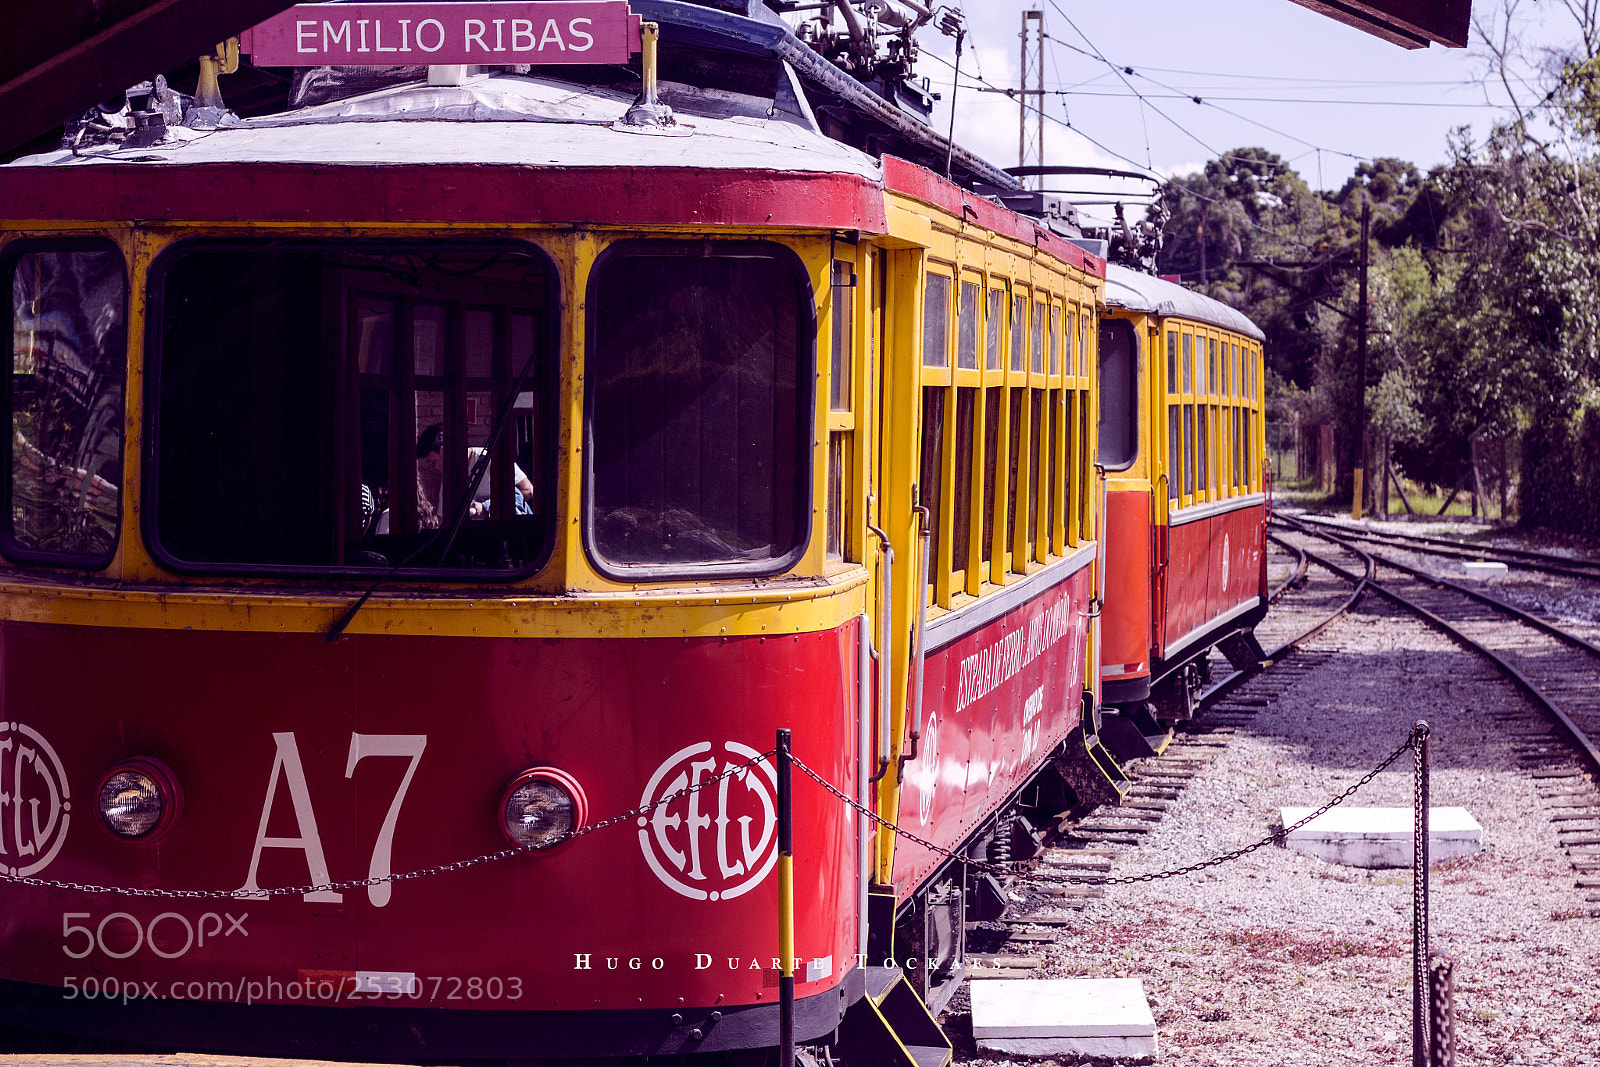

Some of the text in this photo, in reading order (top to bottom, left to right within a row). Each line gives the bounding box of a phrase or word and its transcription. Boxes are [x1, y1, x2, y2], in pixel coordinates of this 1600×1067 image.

[296, 17, 595, 53] EMILIO RIBAS
[233, 731, 428, 908] A7
